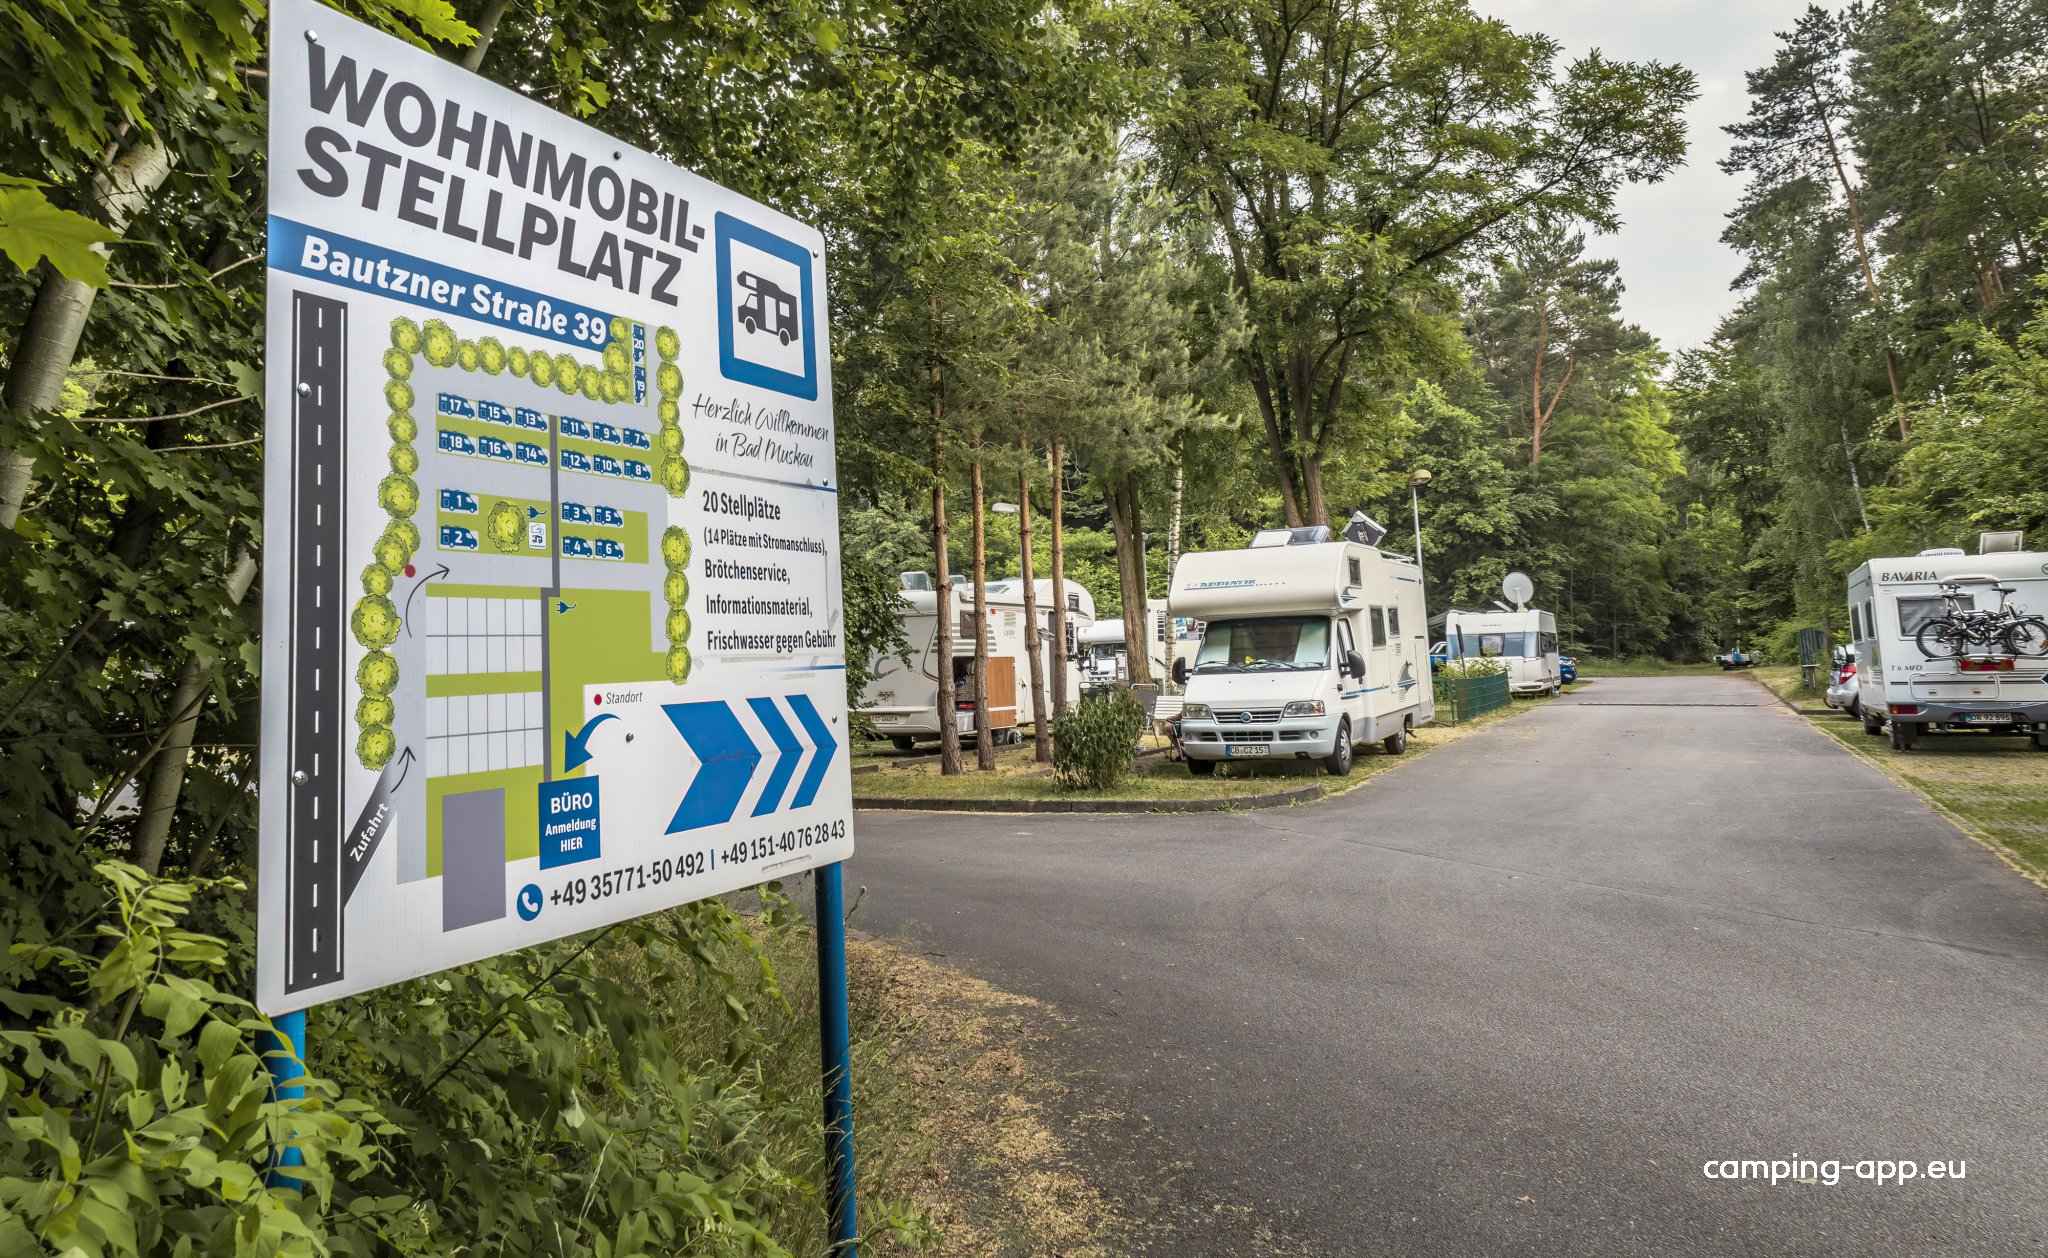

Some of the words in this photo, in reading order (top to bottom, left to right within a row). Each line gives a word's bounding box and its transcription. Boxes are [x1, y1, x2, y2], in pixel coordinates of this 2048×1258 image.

[307, 42, 705, 253] WOHNMOBIL-
[297, 126, 682, 307] STELLPLATZ
[301, 235, 466, 306] Bautzner
[471, 284, 567, 336] Straße
[573, 312, 607, 345] 39
[634, 339, 644, 350] 20
[636, 380, 645, 391] 19
[449, 398, 462, 412] 17
[488, 406, 500, 419] 15
[524, 412, 536, 426] 13
[692, 393, 752, 427] Herzlich
[755, 407, 829, 442] Willkommen
[570, 421, 579, 434] 11
[604, 428, 610, 439] 9
[450, 435, 462, 448] 18
[634, 433, 640, 444] 7
[488, 441, 501, 454] 16
[525, 447, 538, 460] 14
[715, 432, 728, 454] in
[731, 432, 763, 461] Bad
[765, 438, 813, 468] Muskau
[570, 454, 580, 467] 12
[602, 459, 612, 471] 10
[635, 464, 642, 475] 8
[456, 494, 462, 507] 1
[703, 490, 718, 513] 20
[721, 492, 781, 522] Stellplätze
[573, 506, 580, 519] 3
[605, 510, 612, 522] 5
[454, 531, 462, 543] 2
[704, 526, 720, 546] (14
[721, 529, 747, 547] Plätze
[748, 533, 762, 548] mit
[763, 533, 828, 557] Stromanschluss),
[574, 540, 581, 552] 4
[606, 543, 612, 555] 6
[705, 558, 791, 585] Brötchenservice,
[1882, 570, 1938, 582] BAVARIA
[706, 593, 813, 618] Informationsmaterial,
[707, 629, 774, 651] Frischwasser
[776, 634, 804, 654] gegen
[805, 629, 837, 648] Gebühr
[605, 690, 643, 705] Standort
[550, 792, 593, 814] BÜRO
[350, 802, 389, 862] Zufahrt
[545, 818, 597, 837] Anmeldung
[560, 837, 583, 852] HIER
[550, 878, 587, 906] +49
[590, 858, 672, 900] 35771-50
[676, 851, 705, 878] 492
[721, 841, 748, 865] +49
[751, 830, 795, 860] 151-40
[798, 826, 812, 848] 76
[814, 822, 829, 844] 28
[831, 819, 845, 840] 43
